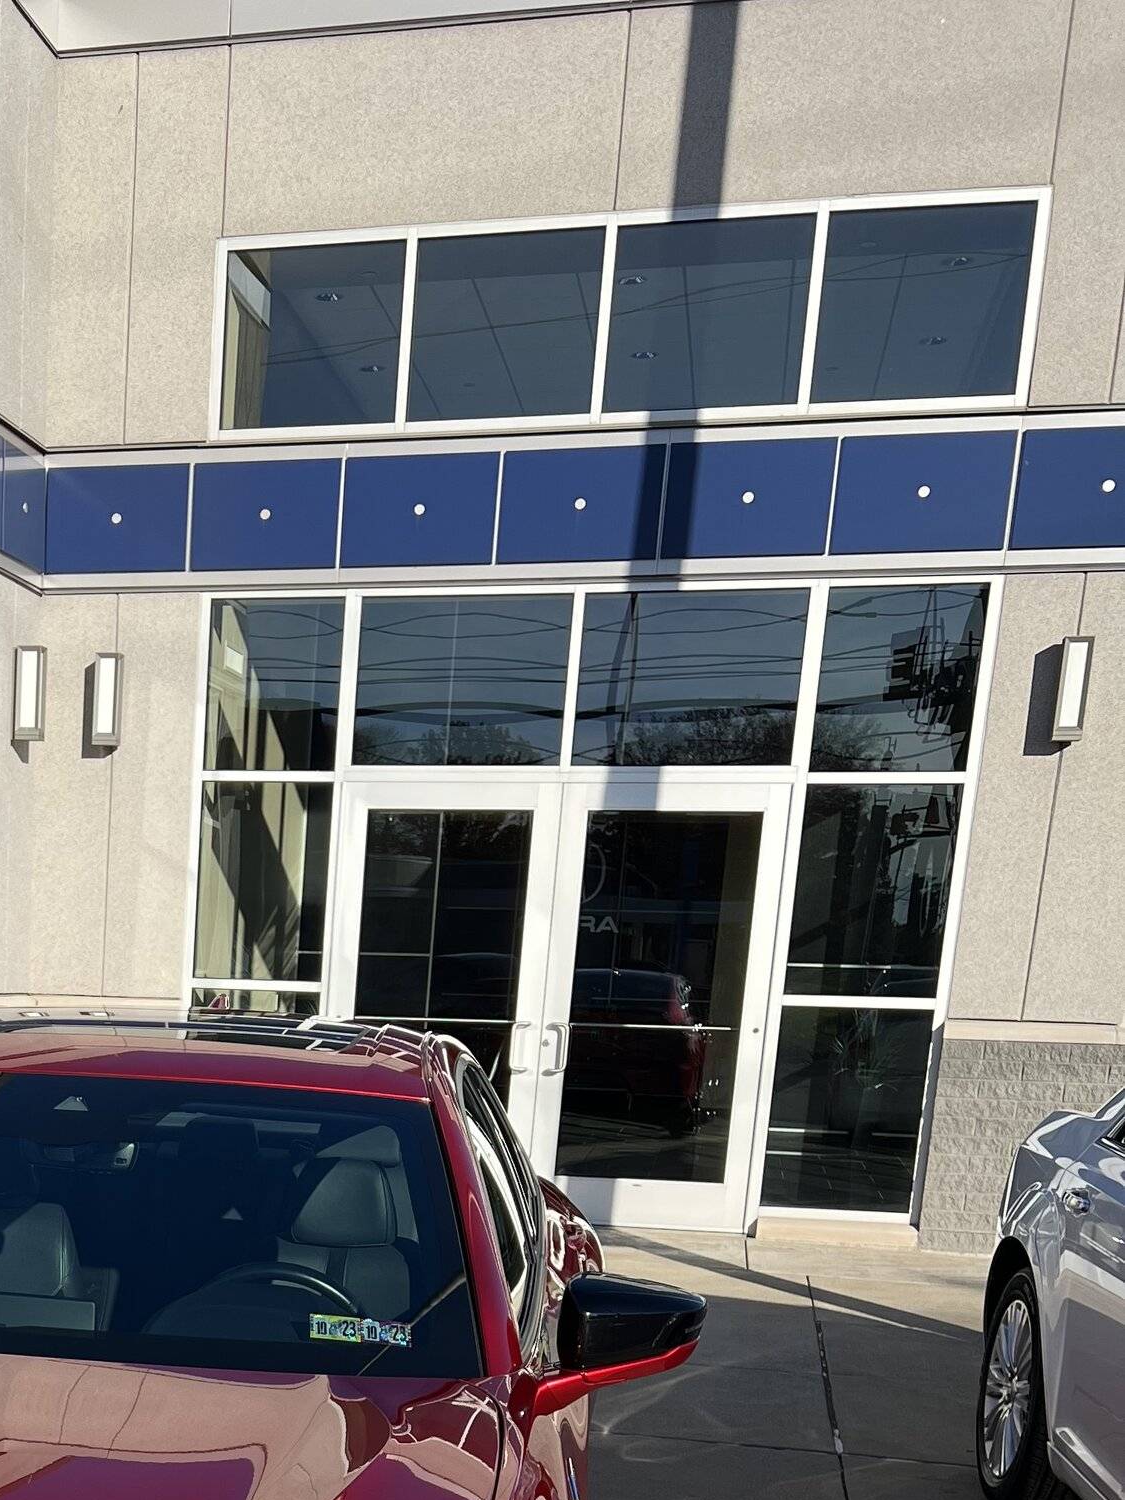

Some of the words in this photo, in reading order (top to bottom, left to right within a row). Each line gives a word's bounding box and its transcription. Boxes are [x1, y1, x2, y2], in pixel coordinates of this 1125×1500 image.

[315, 1320, 328, 1335] 10
[342, 1320, 357, 1337] 23
[365, 1325, 378, 1340] 10
